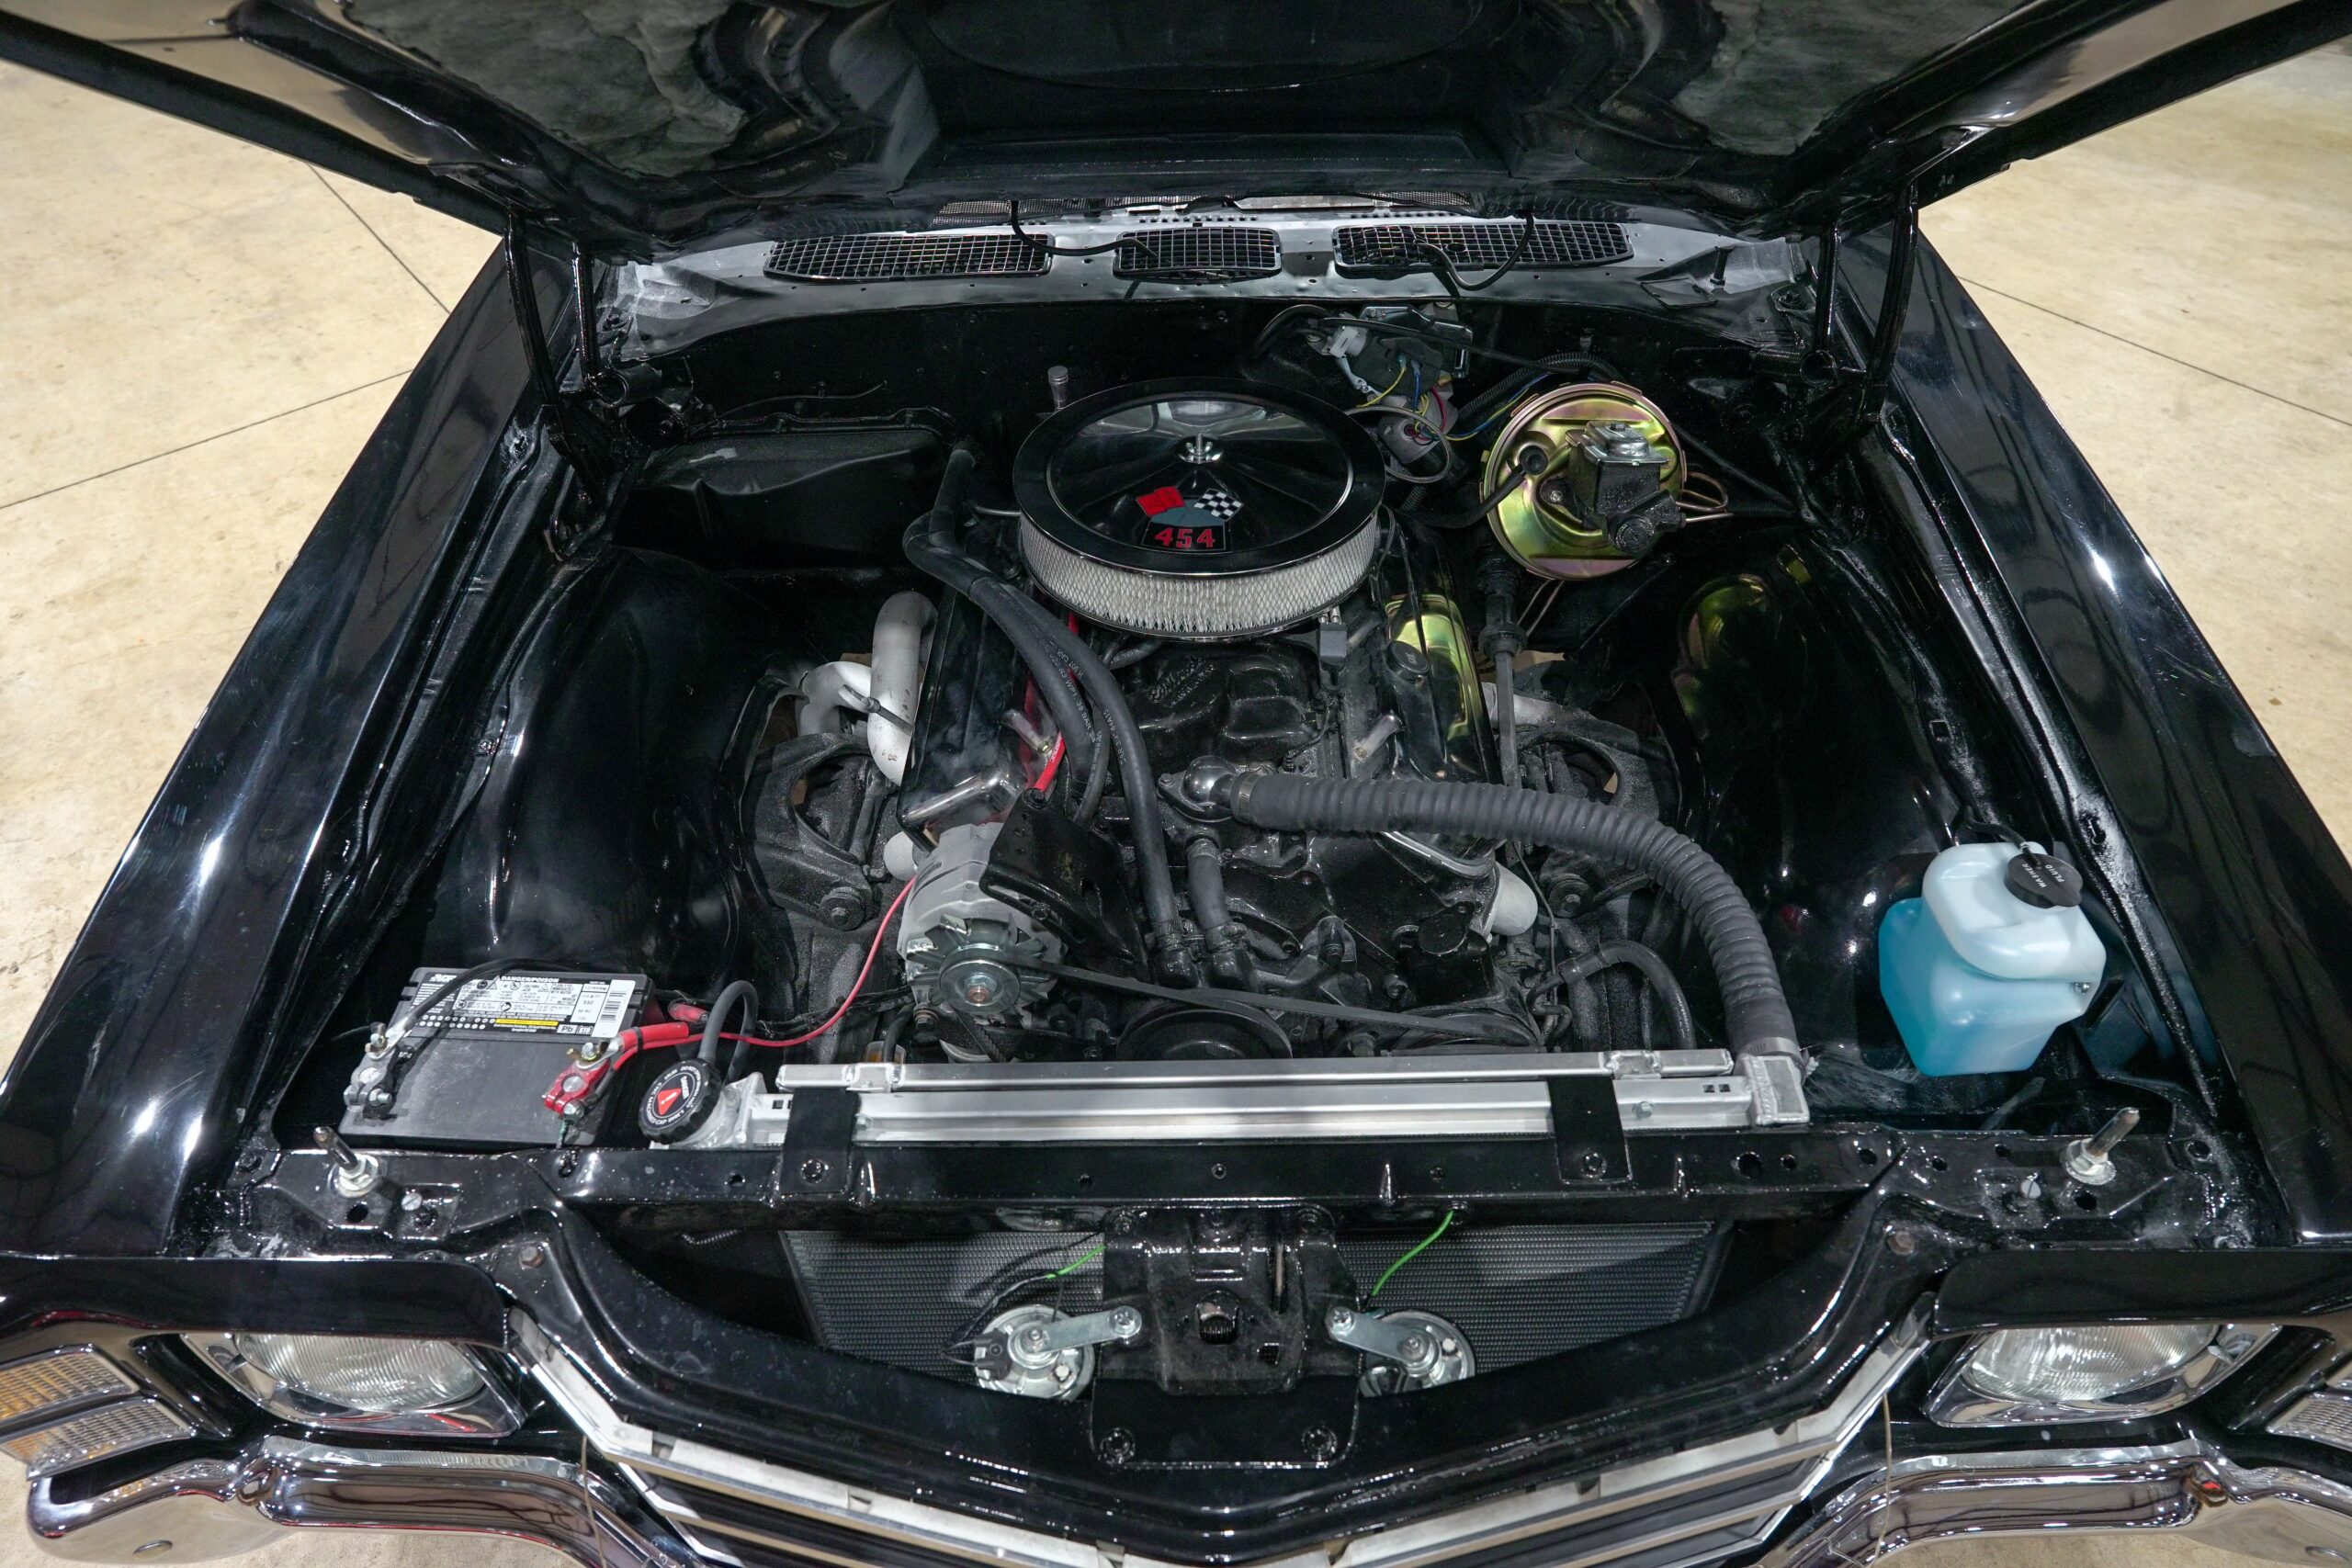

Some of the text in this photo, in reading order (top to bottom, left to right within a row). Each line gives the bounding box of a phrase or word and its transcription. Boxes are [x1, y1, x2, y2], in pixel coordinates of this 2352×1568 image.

[1154, 527, 1216, 548] 454
[2021, 863, 2047, 888] WASHER
[2044, 864, 2065, 883] FLUID
